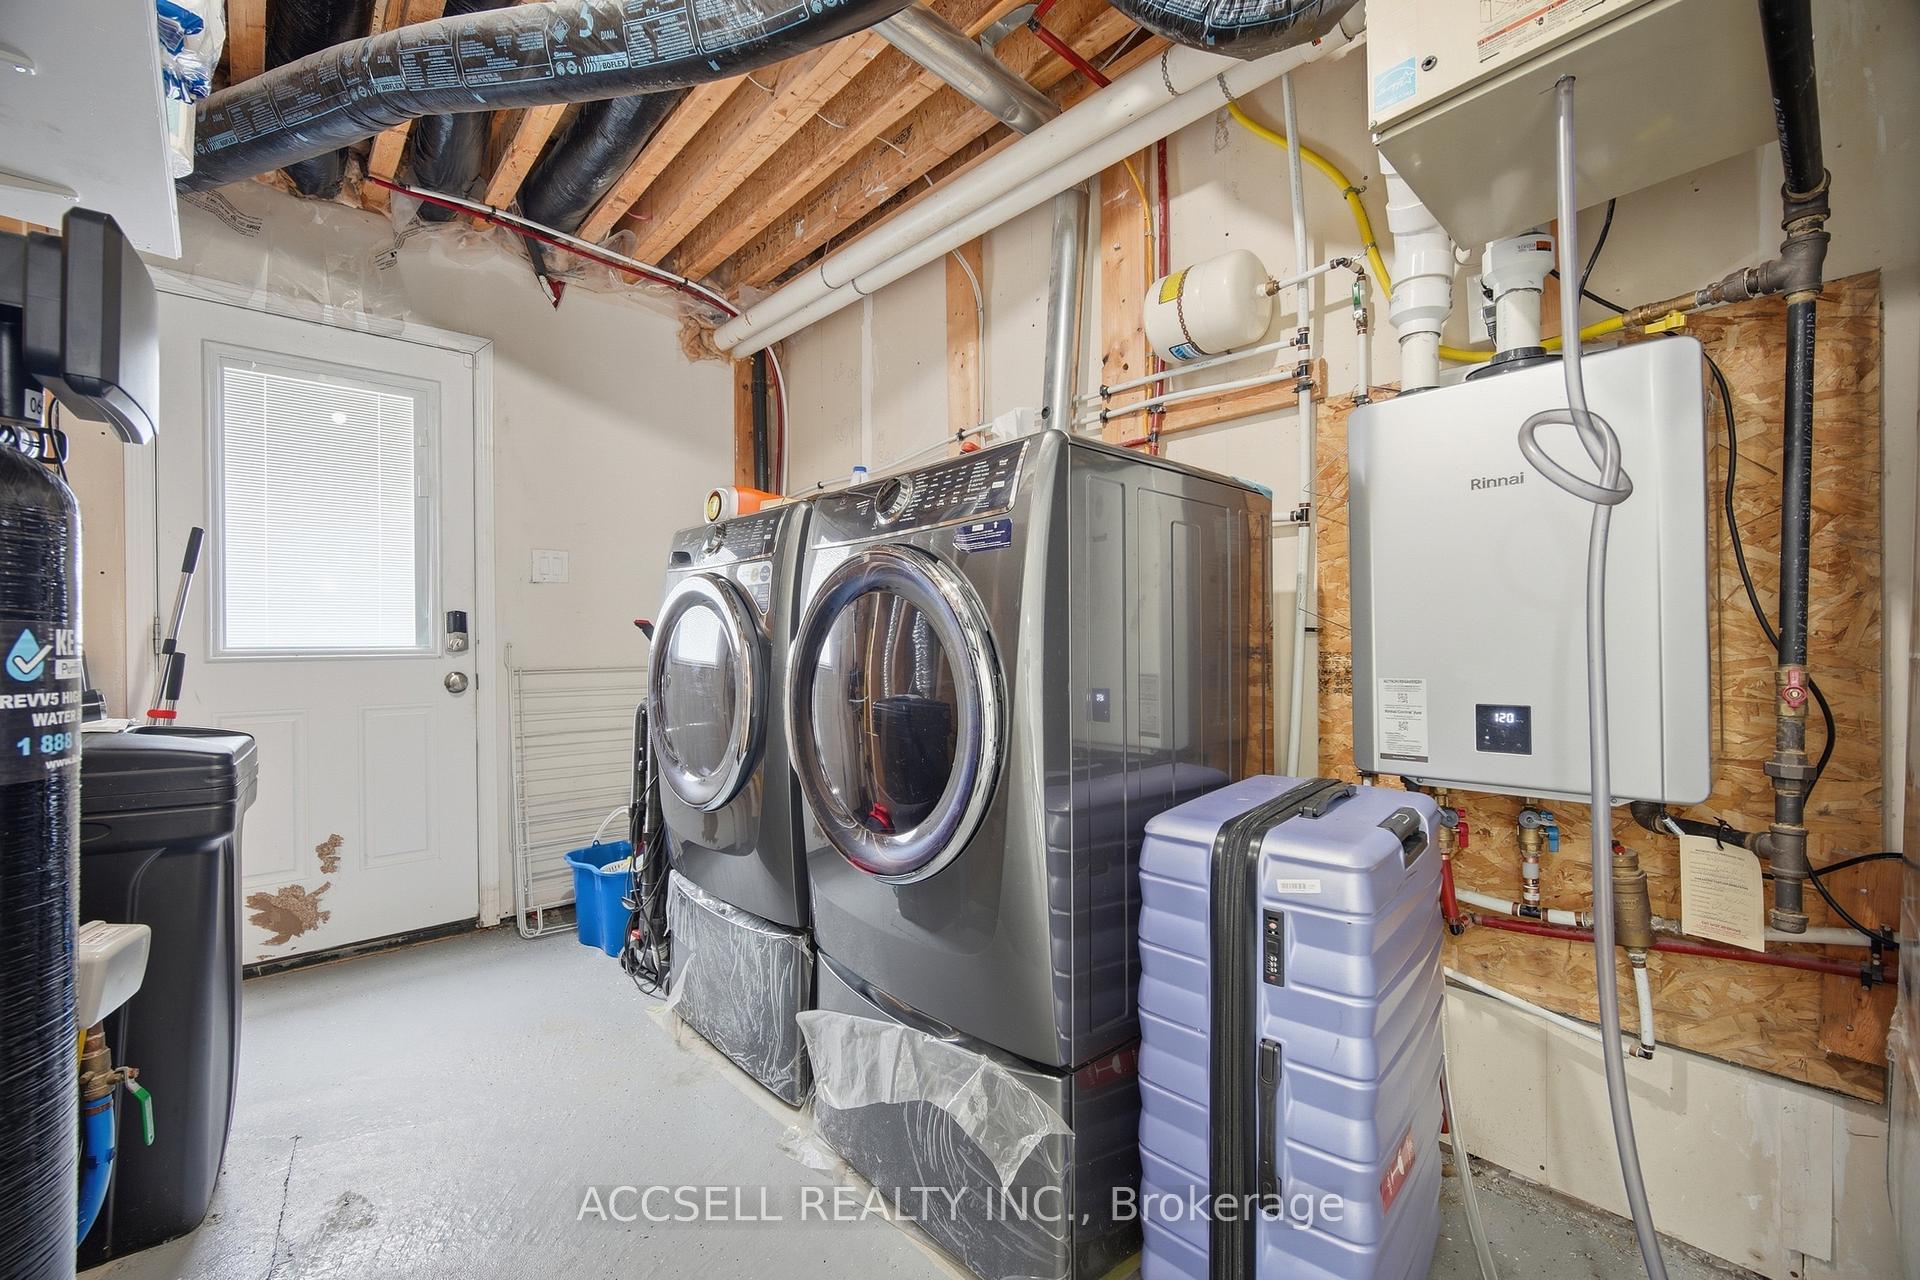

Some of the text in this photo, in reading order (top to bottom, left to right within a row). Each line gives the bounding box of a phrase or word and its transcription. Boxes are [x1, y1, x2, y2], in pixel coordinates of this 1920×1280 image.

[1470, 471, 1525, 490] Rinnai
[1495, 712, 1515, 724] 120
[17, 737, 31, 756] 1
[41, 732, 73, 754] 888
